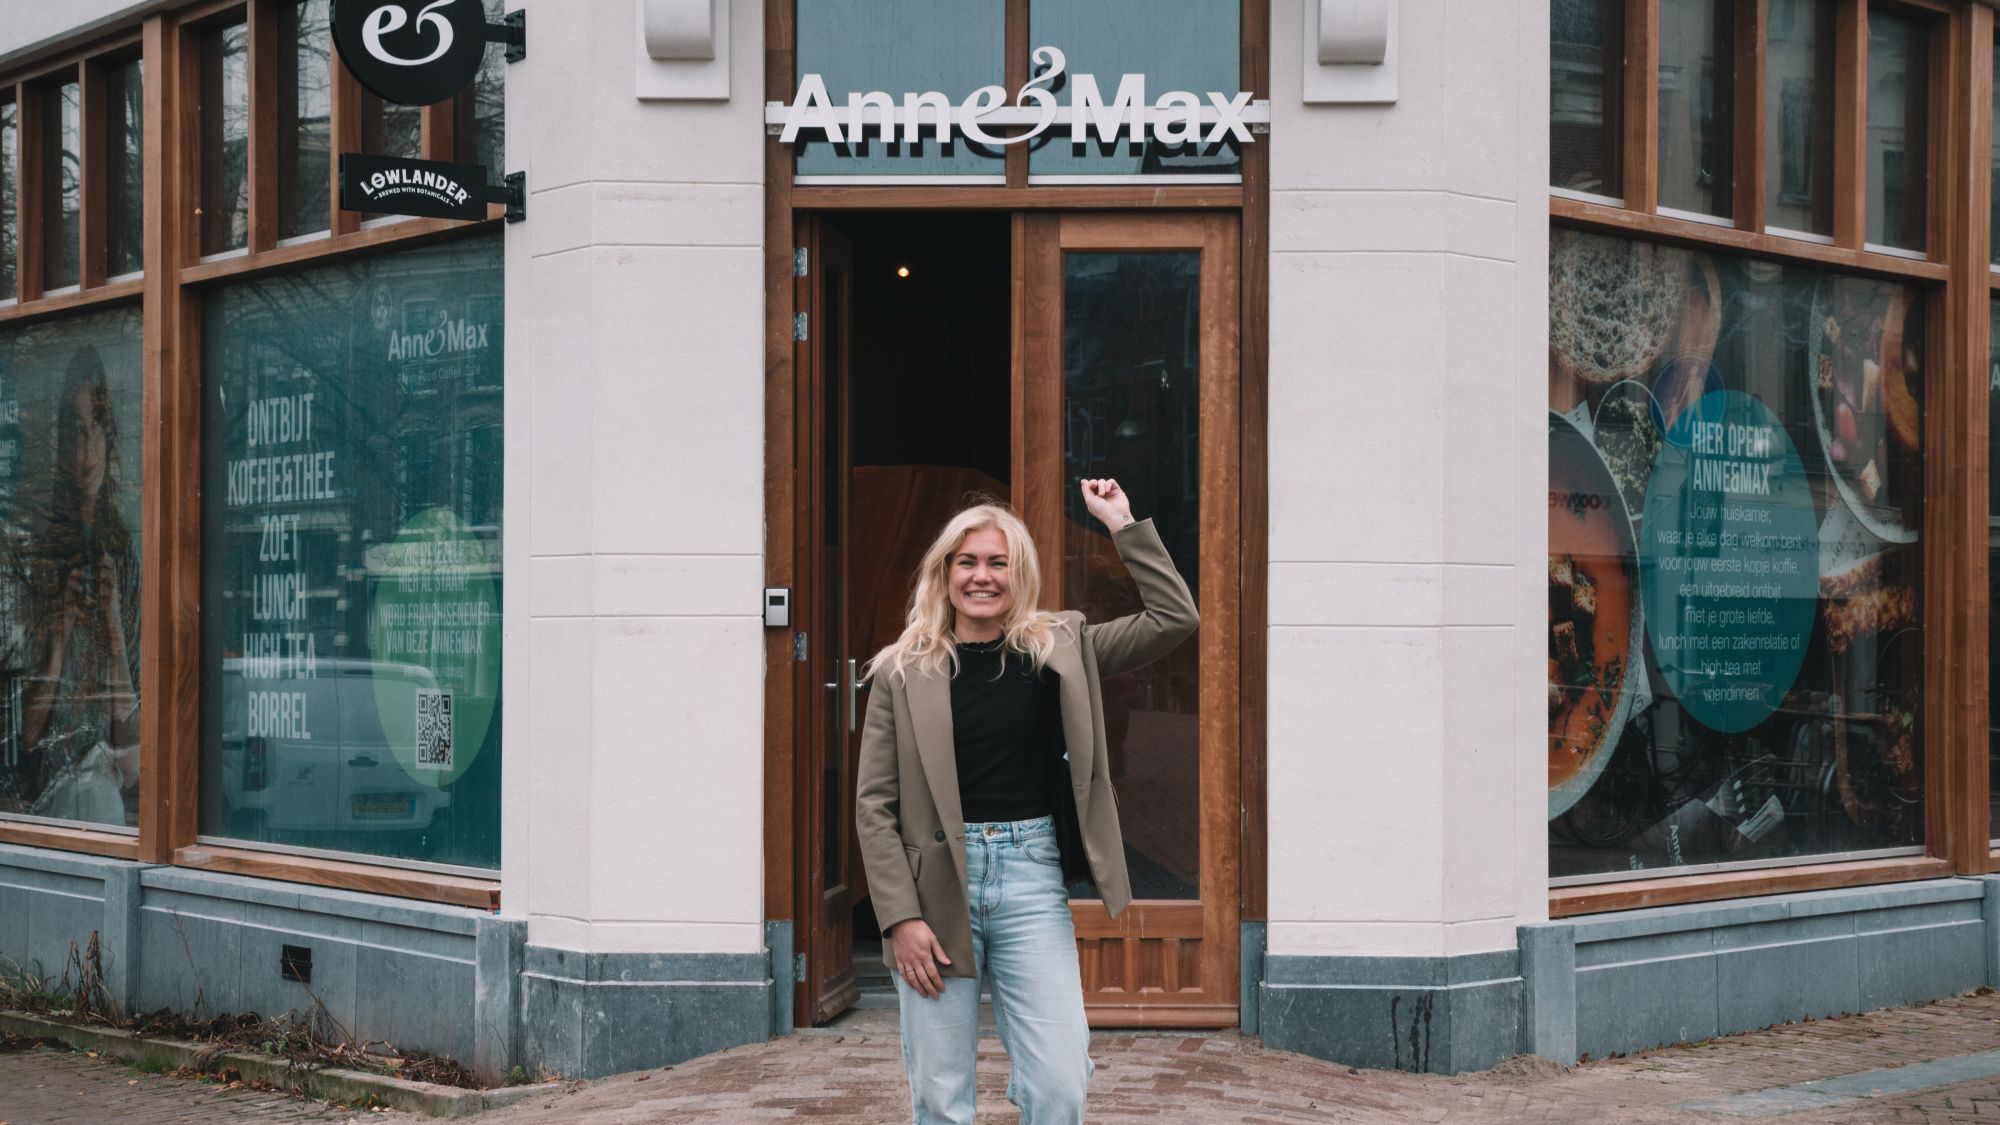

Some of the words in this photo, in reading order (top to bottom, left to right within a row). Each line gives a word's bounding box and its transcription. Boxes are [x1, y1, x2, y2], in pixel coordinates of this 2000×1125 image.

[360, 168, 468, 205] LOWLANDER
[379, 187, 401, 198] BREWED
[416, 187, 450, 204] BOTANICALS
[248, 393, 314, 446] ONTBIJT
[1692, 421, 1724, 455] HIER
[1728, 424, 1772, 458] OPENT
[228, 451, 335, 506] KOFFIE&THEE
[1693, 458, 1770, 495] ANNE&MAX
[1690, 502, 1717, 519] Jouw
[1720, 503, 1772, 524] huiskamer,
[259, 514, 300, 562] ZOET
[1657, 528, 1683, 544] waar
[1685, 529, 1694, 547] je
[1697, 529, 1717, 546] elke
[1720, 530, 1738, 550] dag
[1741, 532, 1778, 549] welkom
[1781, 533, 1802, 550] bent
[1658, 556, 1682, 571] voor
[1684, 556, 1708, 575] jouw
[1711, 559, 1742, 572] eerste
[1744, 558, 1770, 577] kopje
[253, 573, 306, 620] LUNCH
[1679, 583, 1699, 597] een
[1701, 581, 1750, 602] uitgebreid
[1752, 582, 1782, 604] ontbijt
[380, 603, 406, 627] WORD
[408, 601, 490, 626] FRANCHISENEMER
[1685, 607, 1706, 624] met
[1707, 608, 1717, 628] je
[1719, 609, 1745, 628] grote
[1747, 607, 1776, 626] liefde,
[385, 631, 404, 654] VAN
[406, 630, 428, 653] DEZE
[431, 630, 482, 654] ANNE&MAX
[1658, 632, 1687, 650] lunch
[1689, 634, 1709, 650] met
[1711, 635, 1730, 650] een
[1732, 633, 1789, 650] zakenrelatie
[1790, 633, 1801, 650] of
[243, 633, 281, 679] HIGH
[285, 633, 317, 679] TEA
[1700, 659, 1722, 680] high
[1725, 661, 1741, 676] tea
[1742, 660, 1762, 676] met
[248, 692, 311, 739] BORREL
